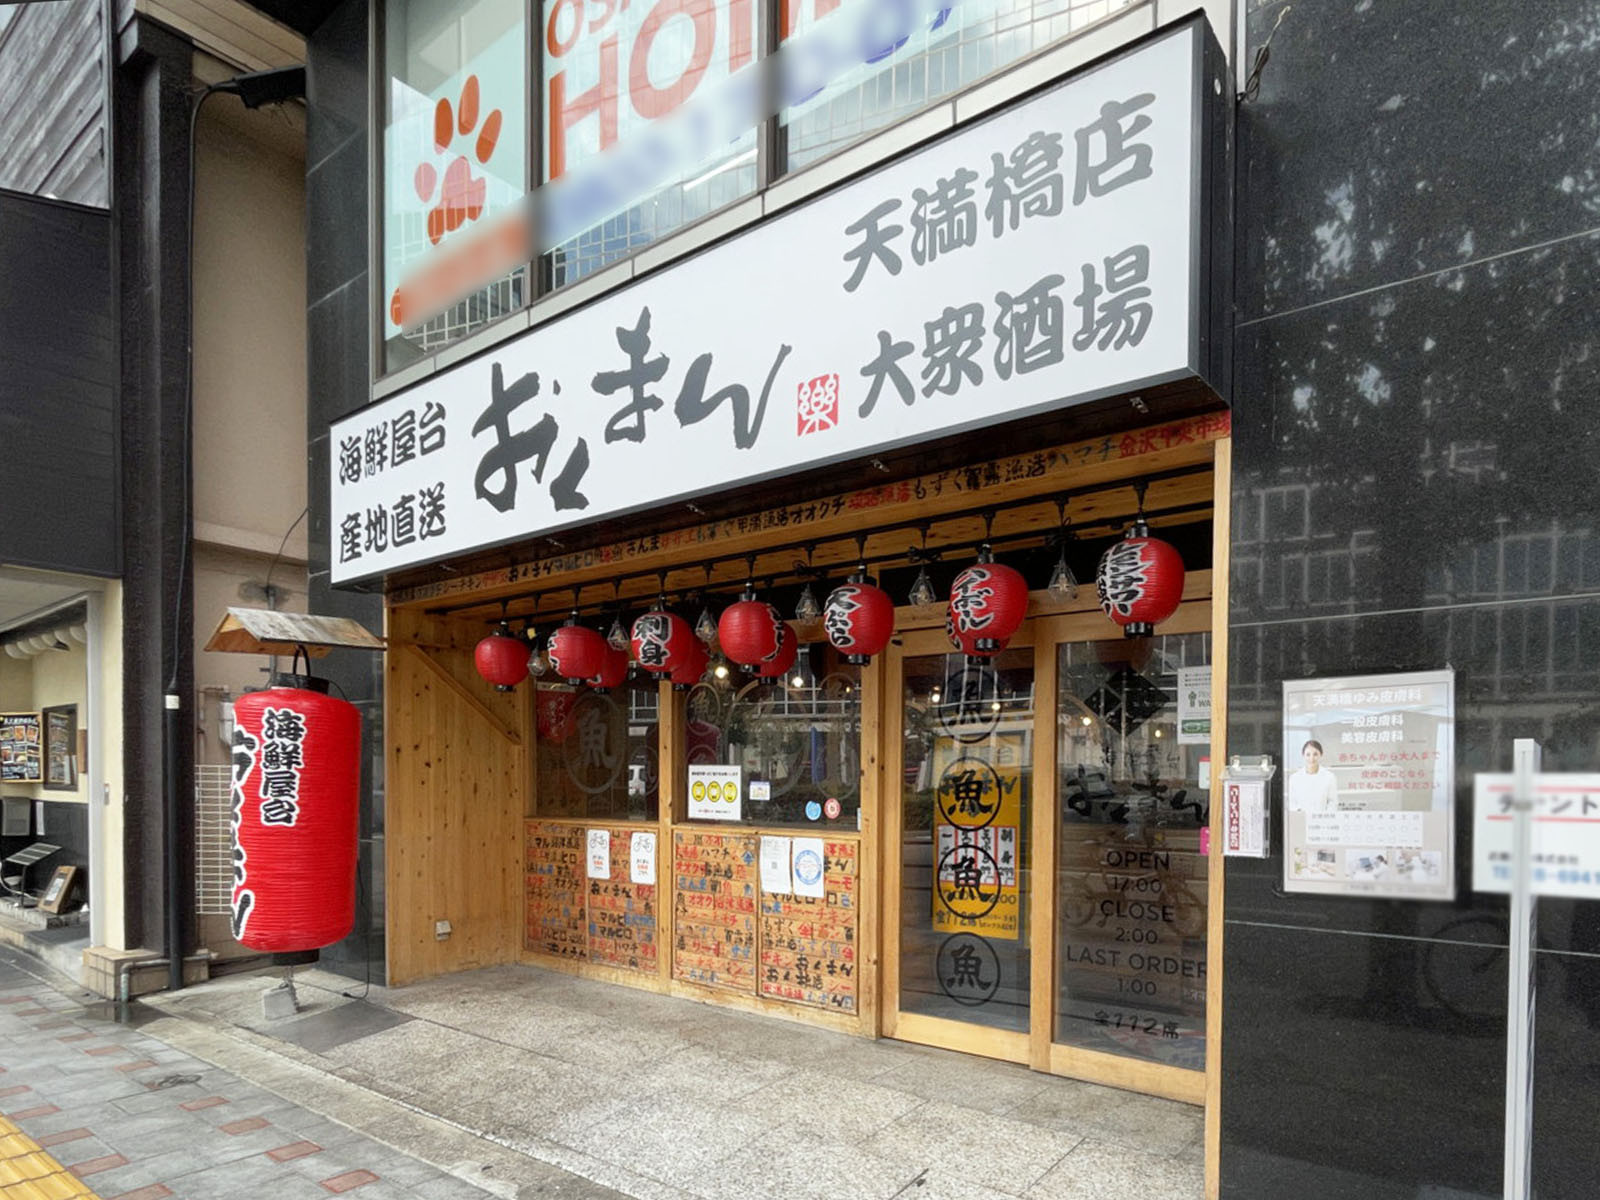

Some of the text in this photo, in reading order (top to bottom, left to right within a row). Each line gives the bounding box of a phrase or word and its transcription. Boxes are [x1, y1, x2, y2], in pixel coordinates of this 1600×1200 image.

[843, 93, 1156, 292] 天満橋店
[858, 244, 1152, 417] 大衆酒場
[339, 402, 446, 486] 海鮮屋台
[339, 481, 446, 564] 産地直送
[824, 586, 863, 649] 天ぷら
[634, 615, 671, 667] 刺身
[261, 708, 305, 826] 海鮮屋台
[947, 770, 994, 816] 魚
[947, 855, 995, 902] 魚
[1107, 850, 1170, 870] OPEN
[1113, 876, 1163, 893] 17:00
[1101, 900, 1175, 922] CLOSE
[1067, 946, 1120, 967] LAST
[1115, 927, 1158, 944] 2:00
[946, 944, 992, 989] 魚
[1118, 978, 1157, 995] 1:00
